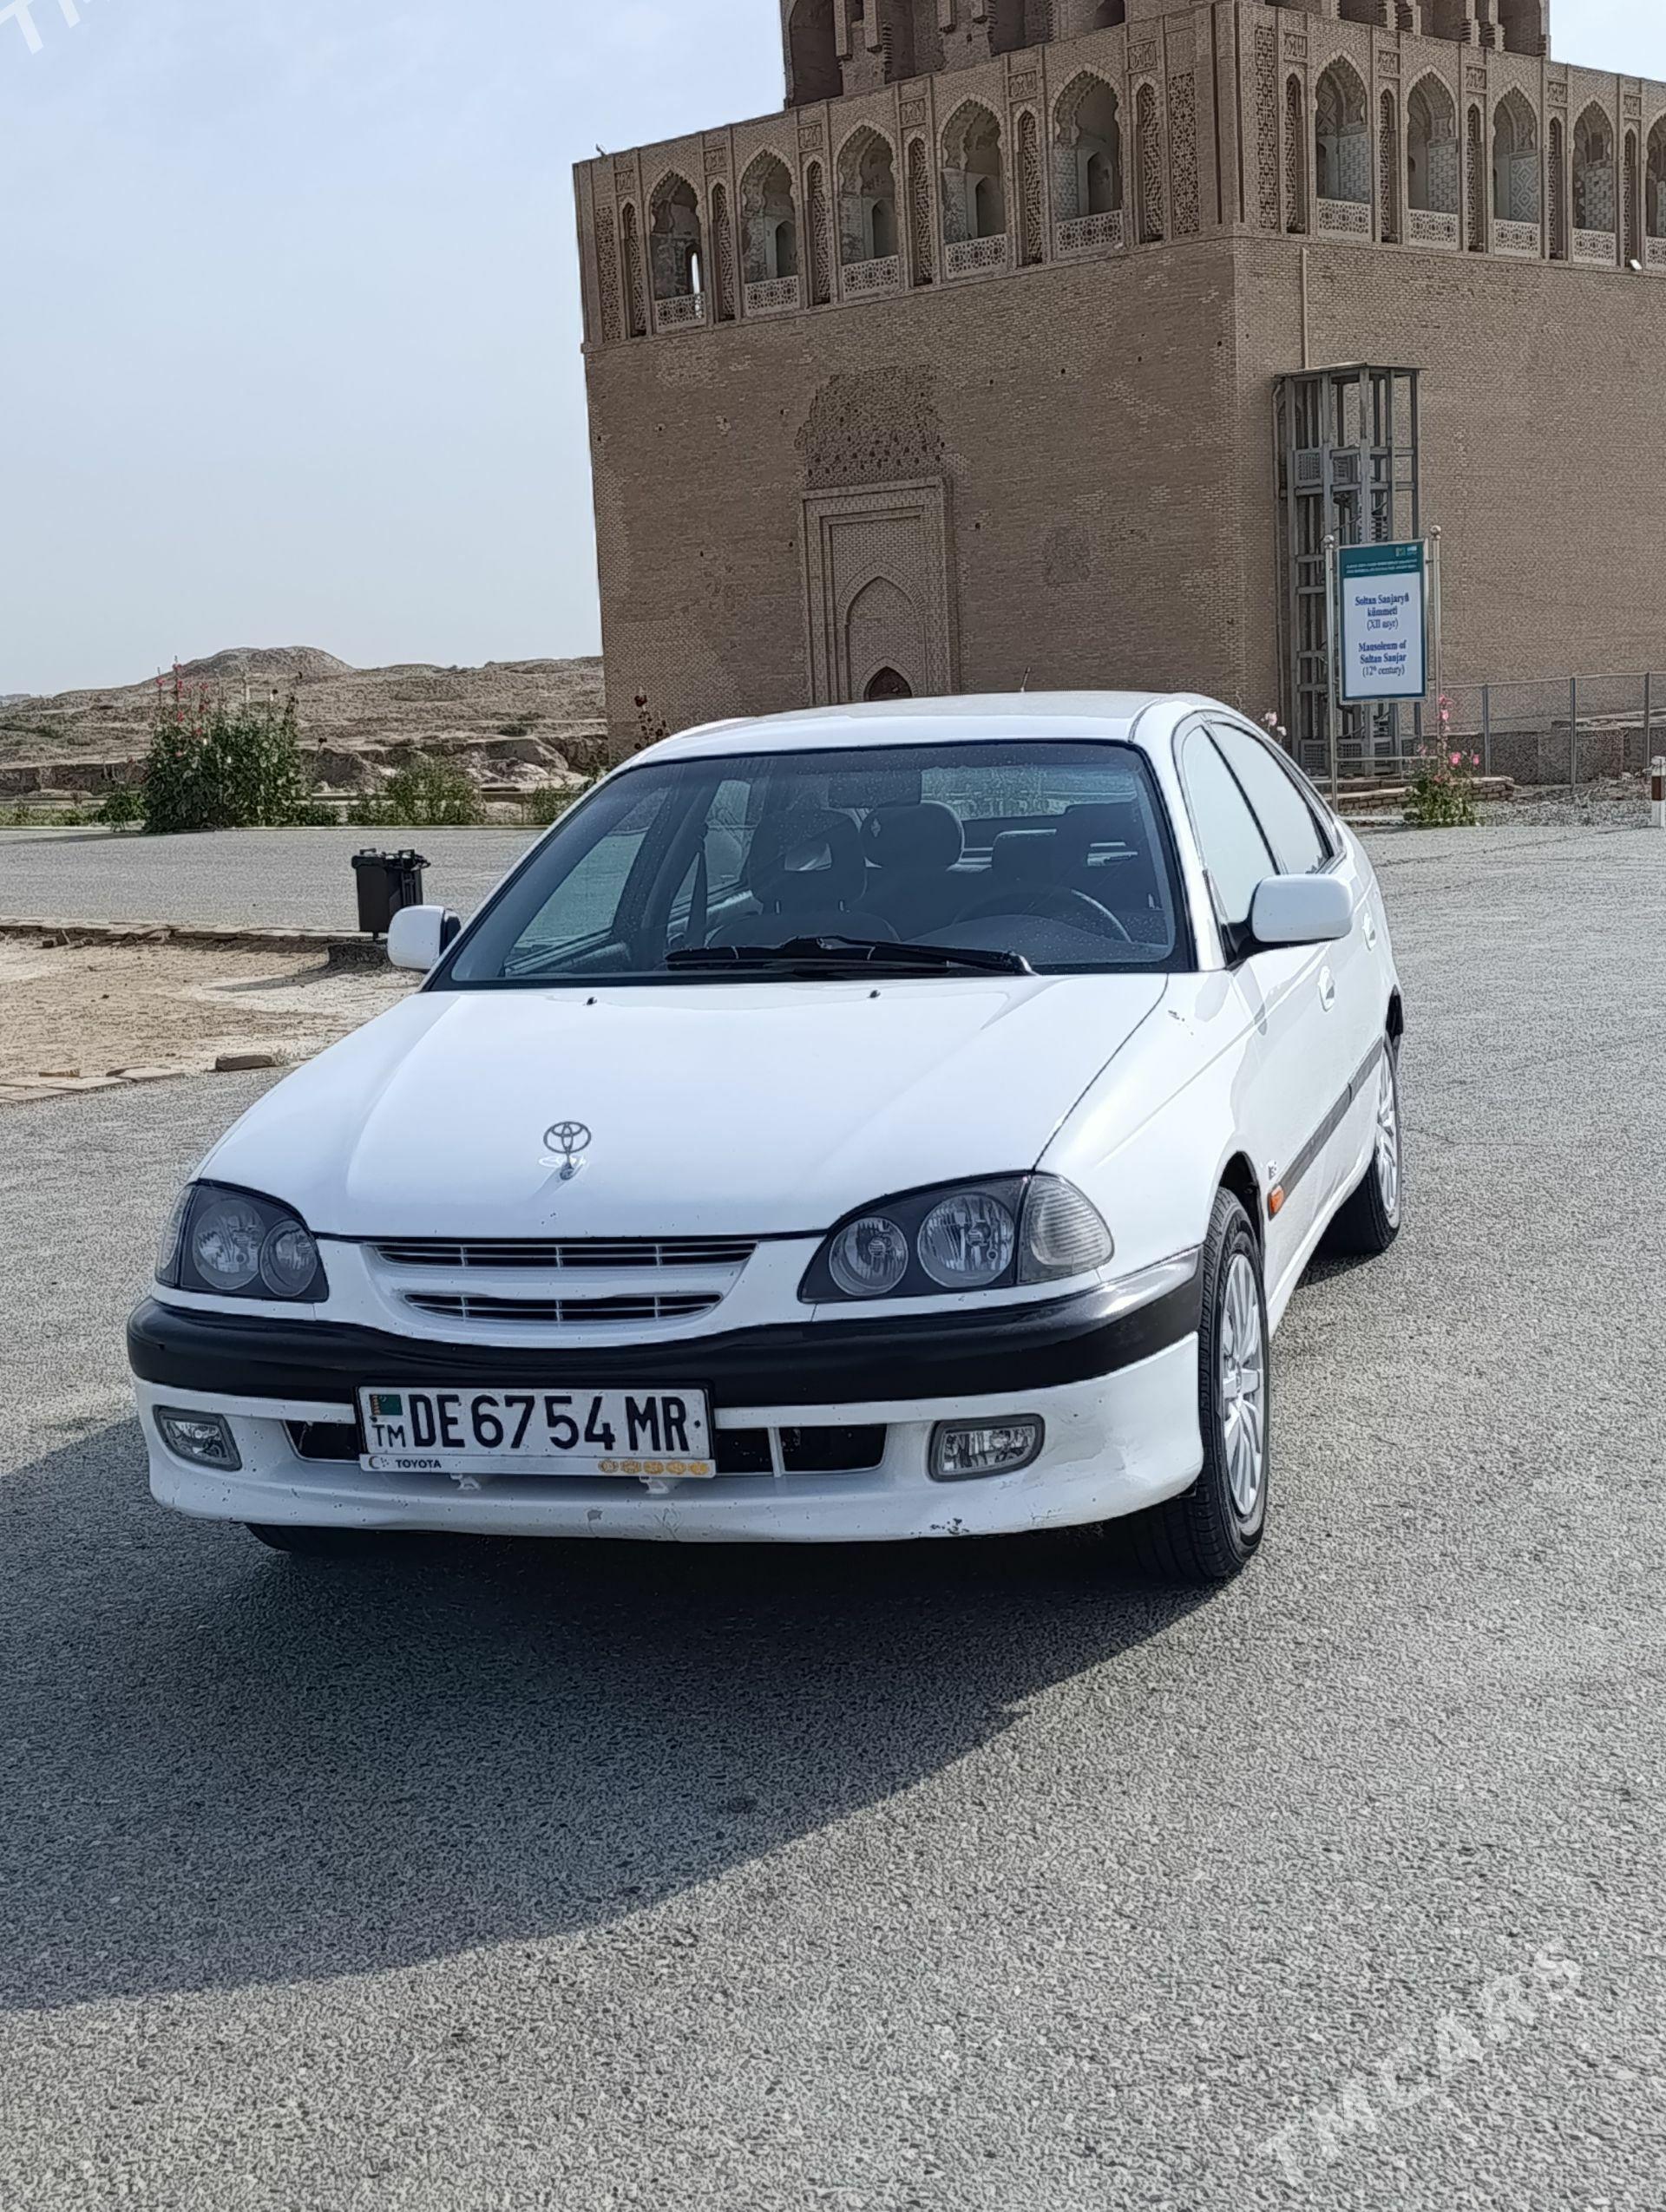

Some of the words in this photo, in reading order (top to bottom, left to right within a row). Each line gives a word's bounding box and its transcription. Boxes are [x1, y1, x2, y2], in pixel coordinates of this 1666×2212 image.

[1358, 641, 1398, 652] Mausoleum
[1399, 639, 1407, 650] of
[1383, 652, 1407, 664] Sanjar
[1378, 664, 1405, 677] century)
[371, 1423, 406, 1448] TM
[396, 1459, 442, 1469] TOYOTA
